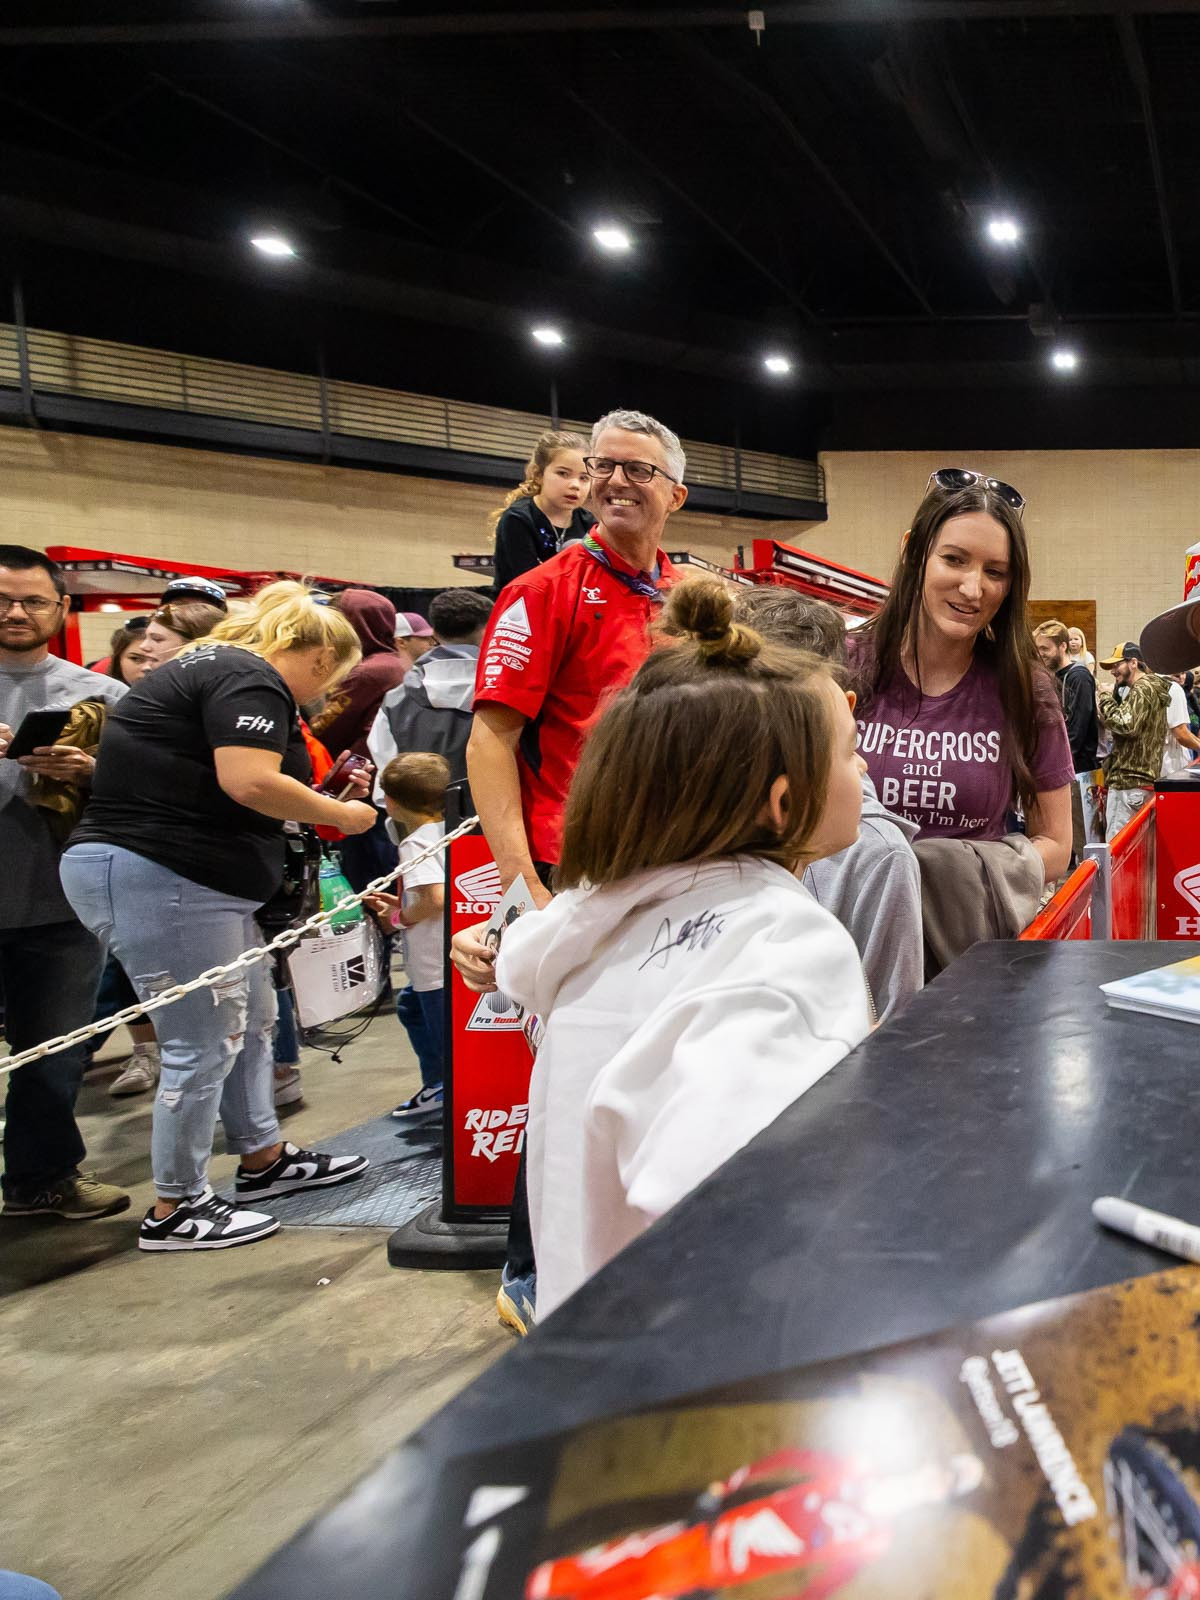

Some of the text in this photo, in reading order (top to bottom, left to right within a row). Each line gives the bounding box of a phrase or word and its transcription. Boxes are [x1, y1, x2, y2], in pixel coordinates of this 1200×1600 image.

[856, 719, 1001, 763] SUPERCROSS
[902, 760, 942, 777] and
[882, 777, 957, 811] BEER
[928, 811, 954, 826] I'm
[959, 814, 988, 829] here
[474, 1016, 492, 1024] Pro
[464, 1103, 529, 1132] RIDE
